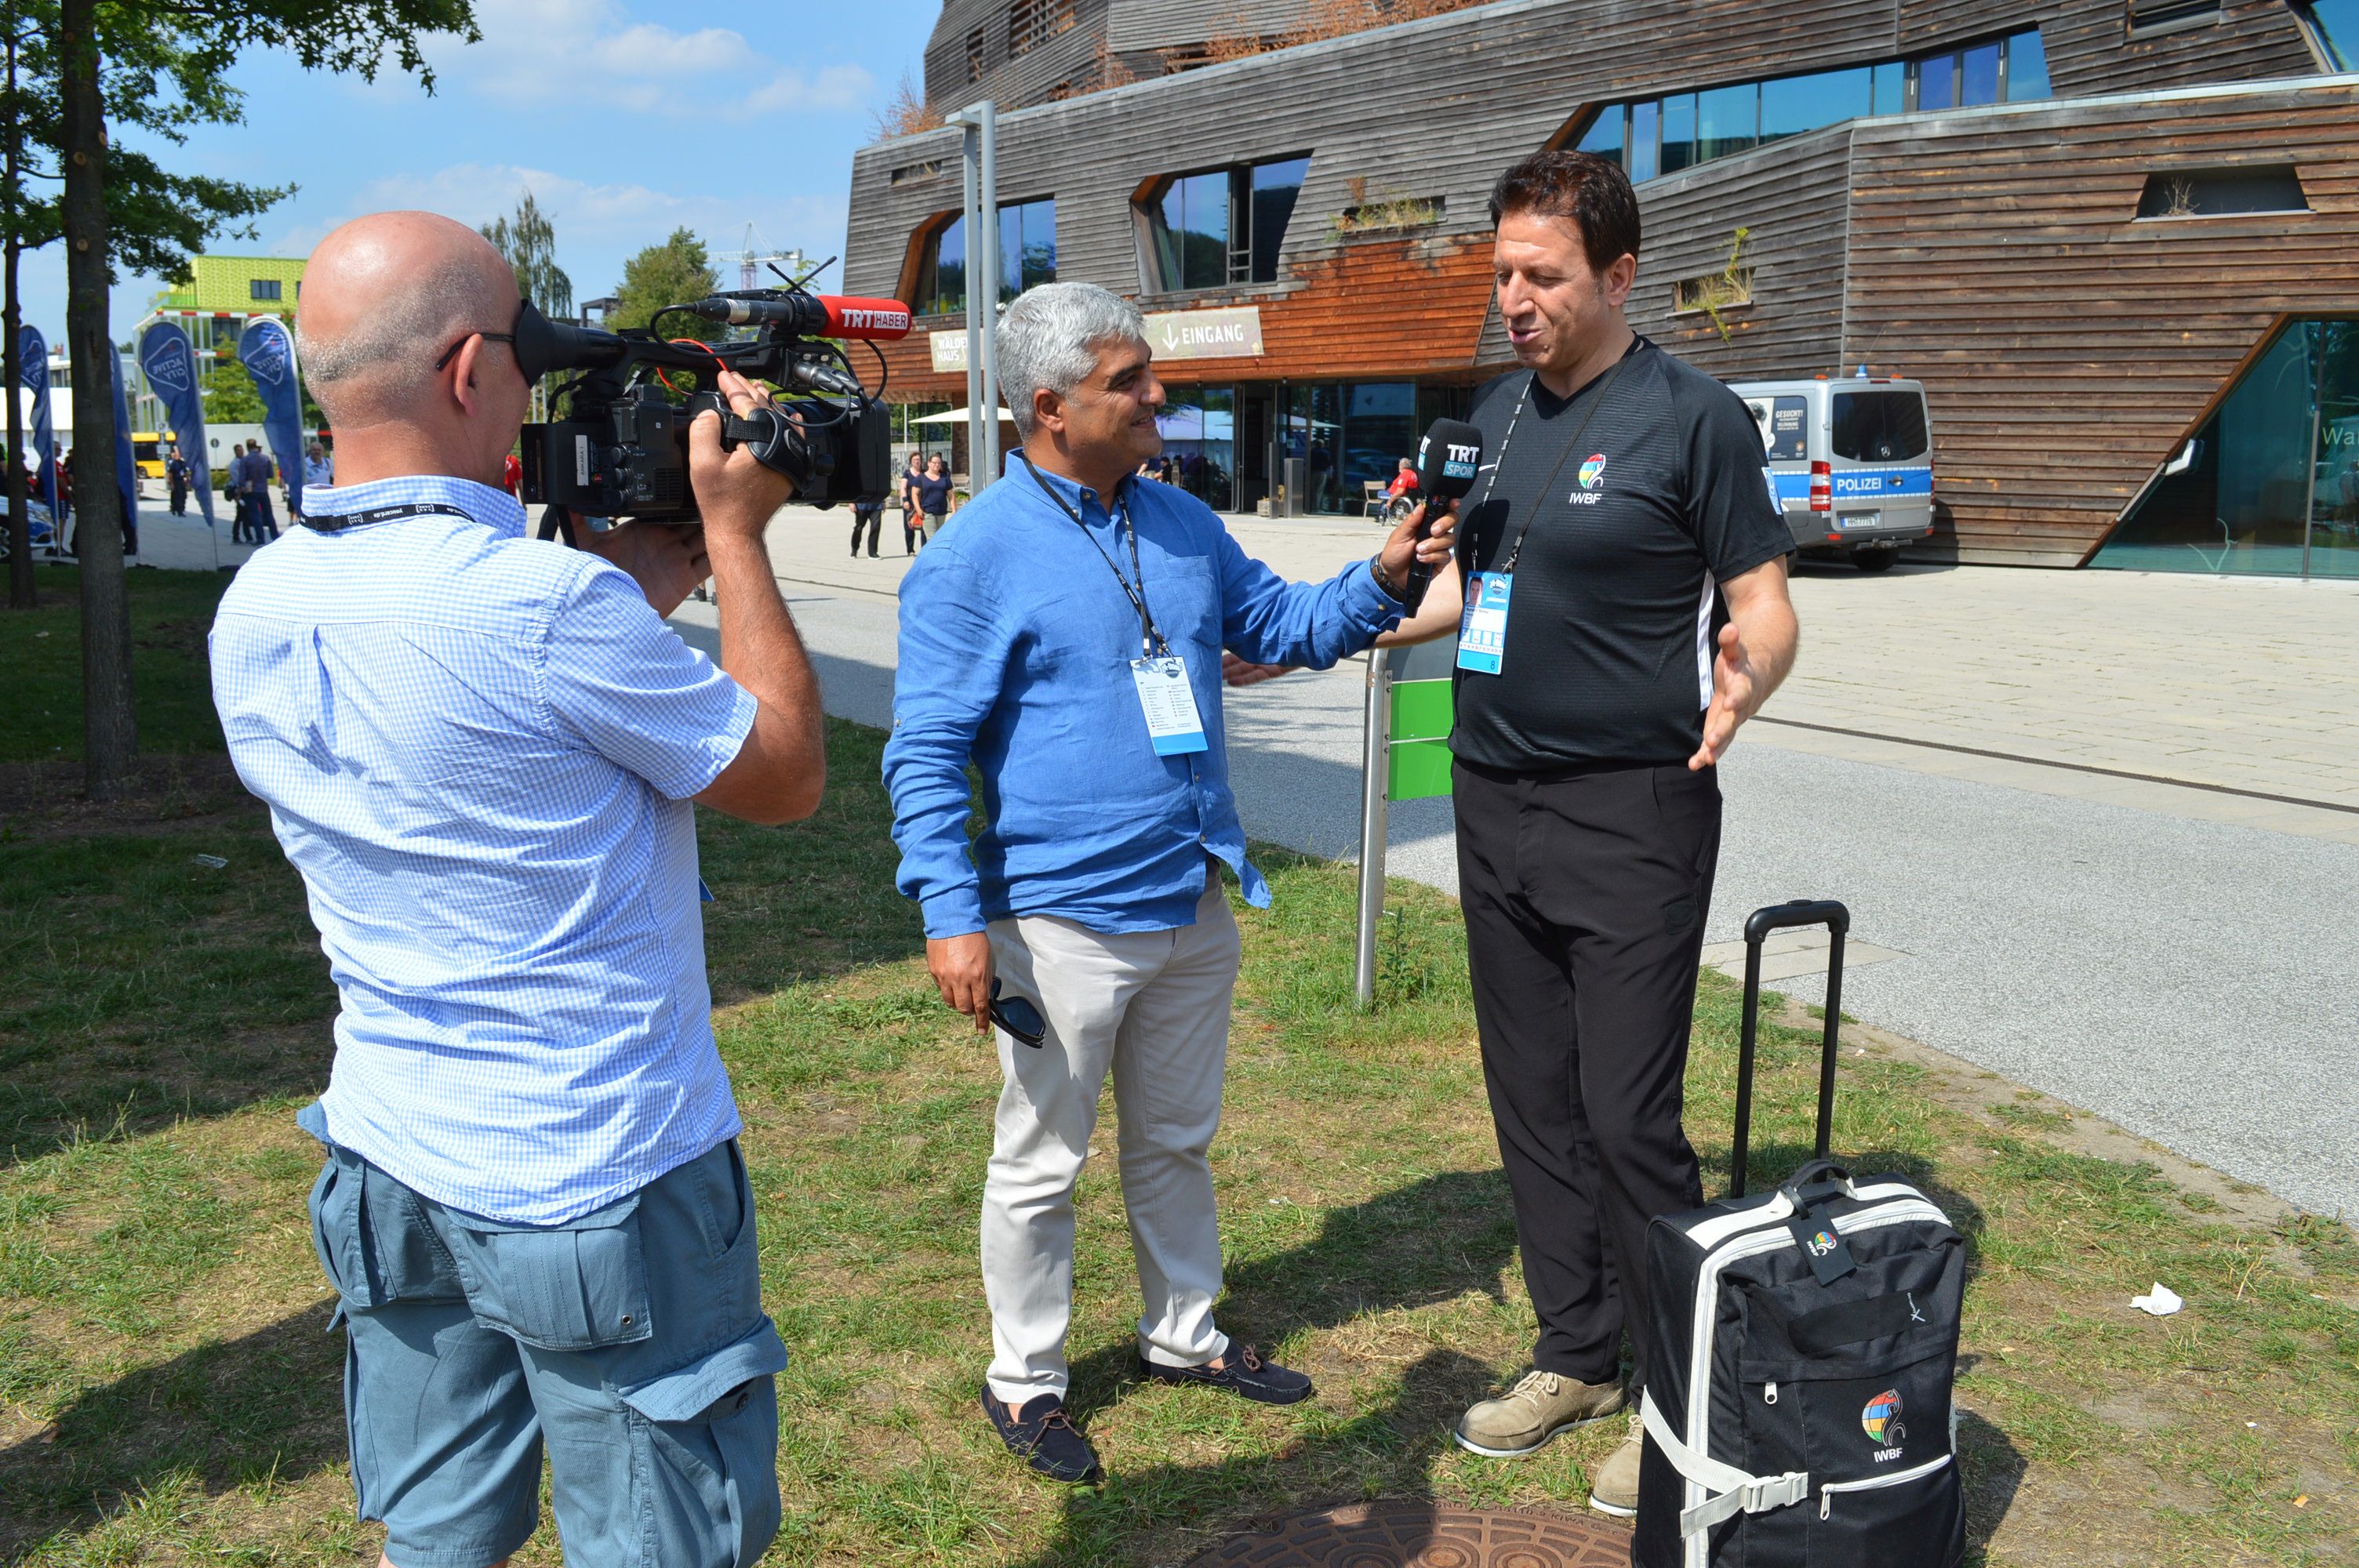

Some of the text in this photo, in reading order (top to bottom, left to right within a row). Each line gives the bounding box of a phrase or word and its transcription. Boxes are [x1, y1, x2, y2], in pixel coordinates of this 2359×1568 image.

[841, 309, 907, 328] TRT HABER
[1182, 324, 1244, 345] EINGANG
[936, 350, 960, 362] HAUS
[1776, 409, 1803, 418] GESUCHT!
[1447, 444, 1480, 463] TRT
[1446, 464, 1474, 477] SPOR
[1837, 477, 1881, 492] POLIZEI
[1569, 492, 1602, 504] IWBF
[1490, 660, 1496, 670] 8
[1807, 1240, 1819, 1257] IWBF
[1874, 1447, 1903, 1463] IWBF
